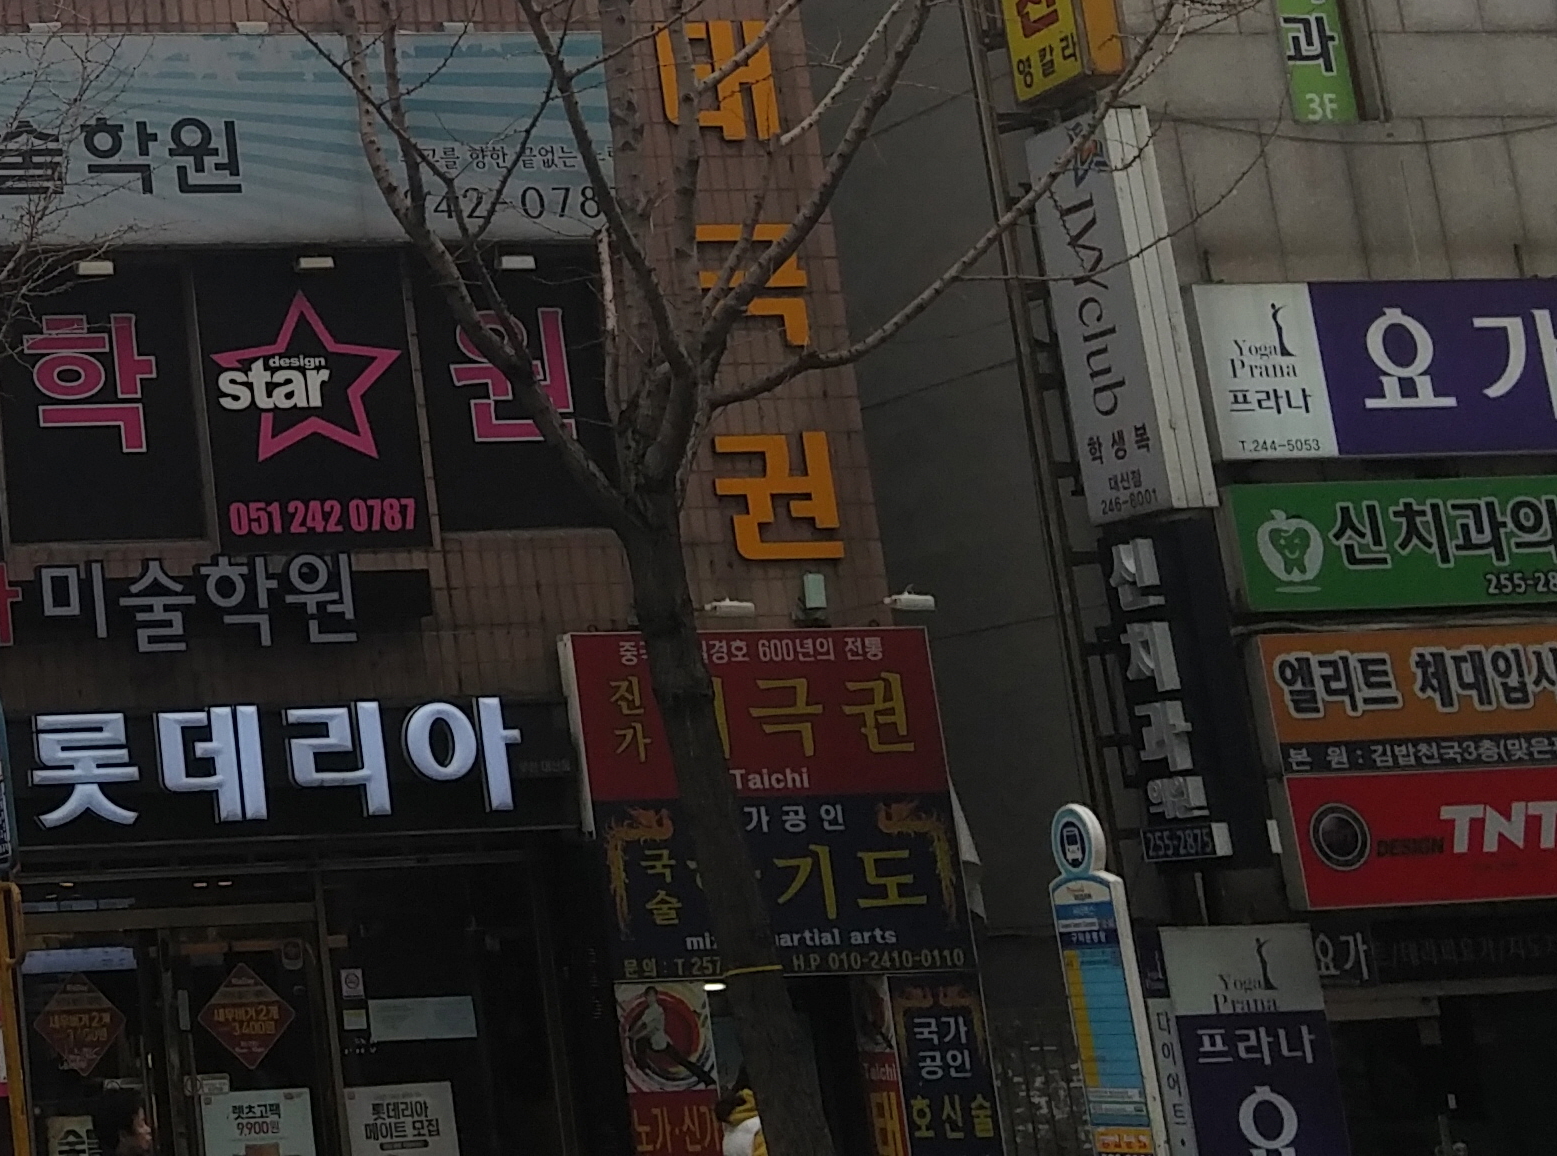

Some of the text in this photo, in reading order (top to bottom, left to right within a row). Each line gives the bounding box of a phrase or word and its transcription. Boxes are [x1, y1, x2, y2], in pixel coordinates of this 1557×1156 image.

[1305, 92, 1339, 121] 3F
[268, 354, 326, 369] design
[1233, 339, 1278, 358] Yoga
[1364, 307, 1557, 420] 요가
[23, 312, 157, 454] 학
[451, 306, 578, 444] 원
[1229, 359, 1298, 379] Prana
[217, 365, 330, 412] star
[1229, 387, 1312, 415] 프라나
[229, 497, 416, 537] 051 242 0787
[40, 551, 361, 654] 미술학원
[757, 635, 835, 663] 600년의
[844, 635, 884, 661] 전통
[29, 696, 522, 829] 롯데리아
[728, 766, 811, 791] Taichi
[1145, 826, 1212, 857] 255-2875
[1440, 801, 1557, 854] TNT
[848, 927, 898, 945] arts
[828, 947, 966, 971] 010-2410-0110
[1315, 931, 1370, 982] 요가
[1218, 973, 1262, 992] Yoga
[913, 1015, 968, 1045] 국가
[1196, 1025, 1317, 1067] 프라나
[918, 1049, 972, 1080] 공인
[371, 1101, 429, 1121] 롯데리아
[910, 1094, 994, 1140] 호신술
[364, 1118, 440, 1141] 메이트 모집
